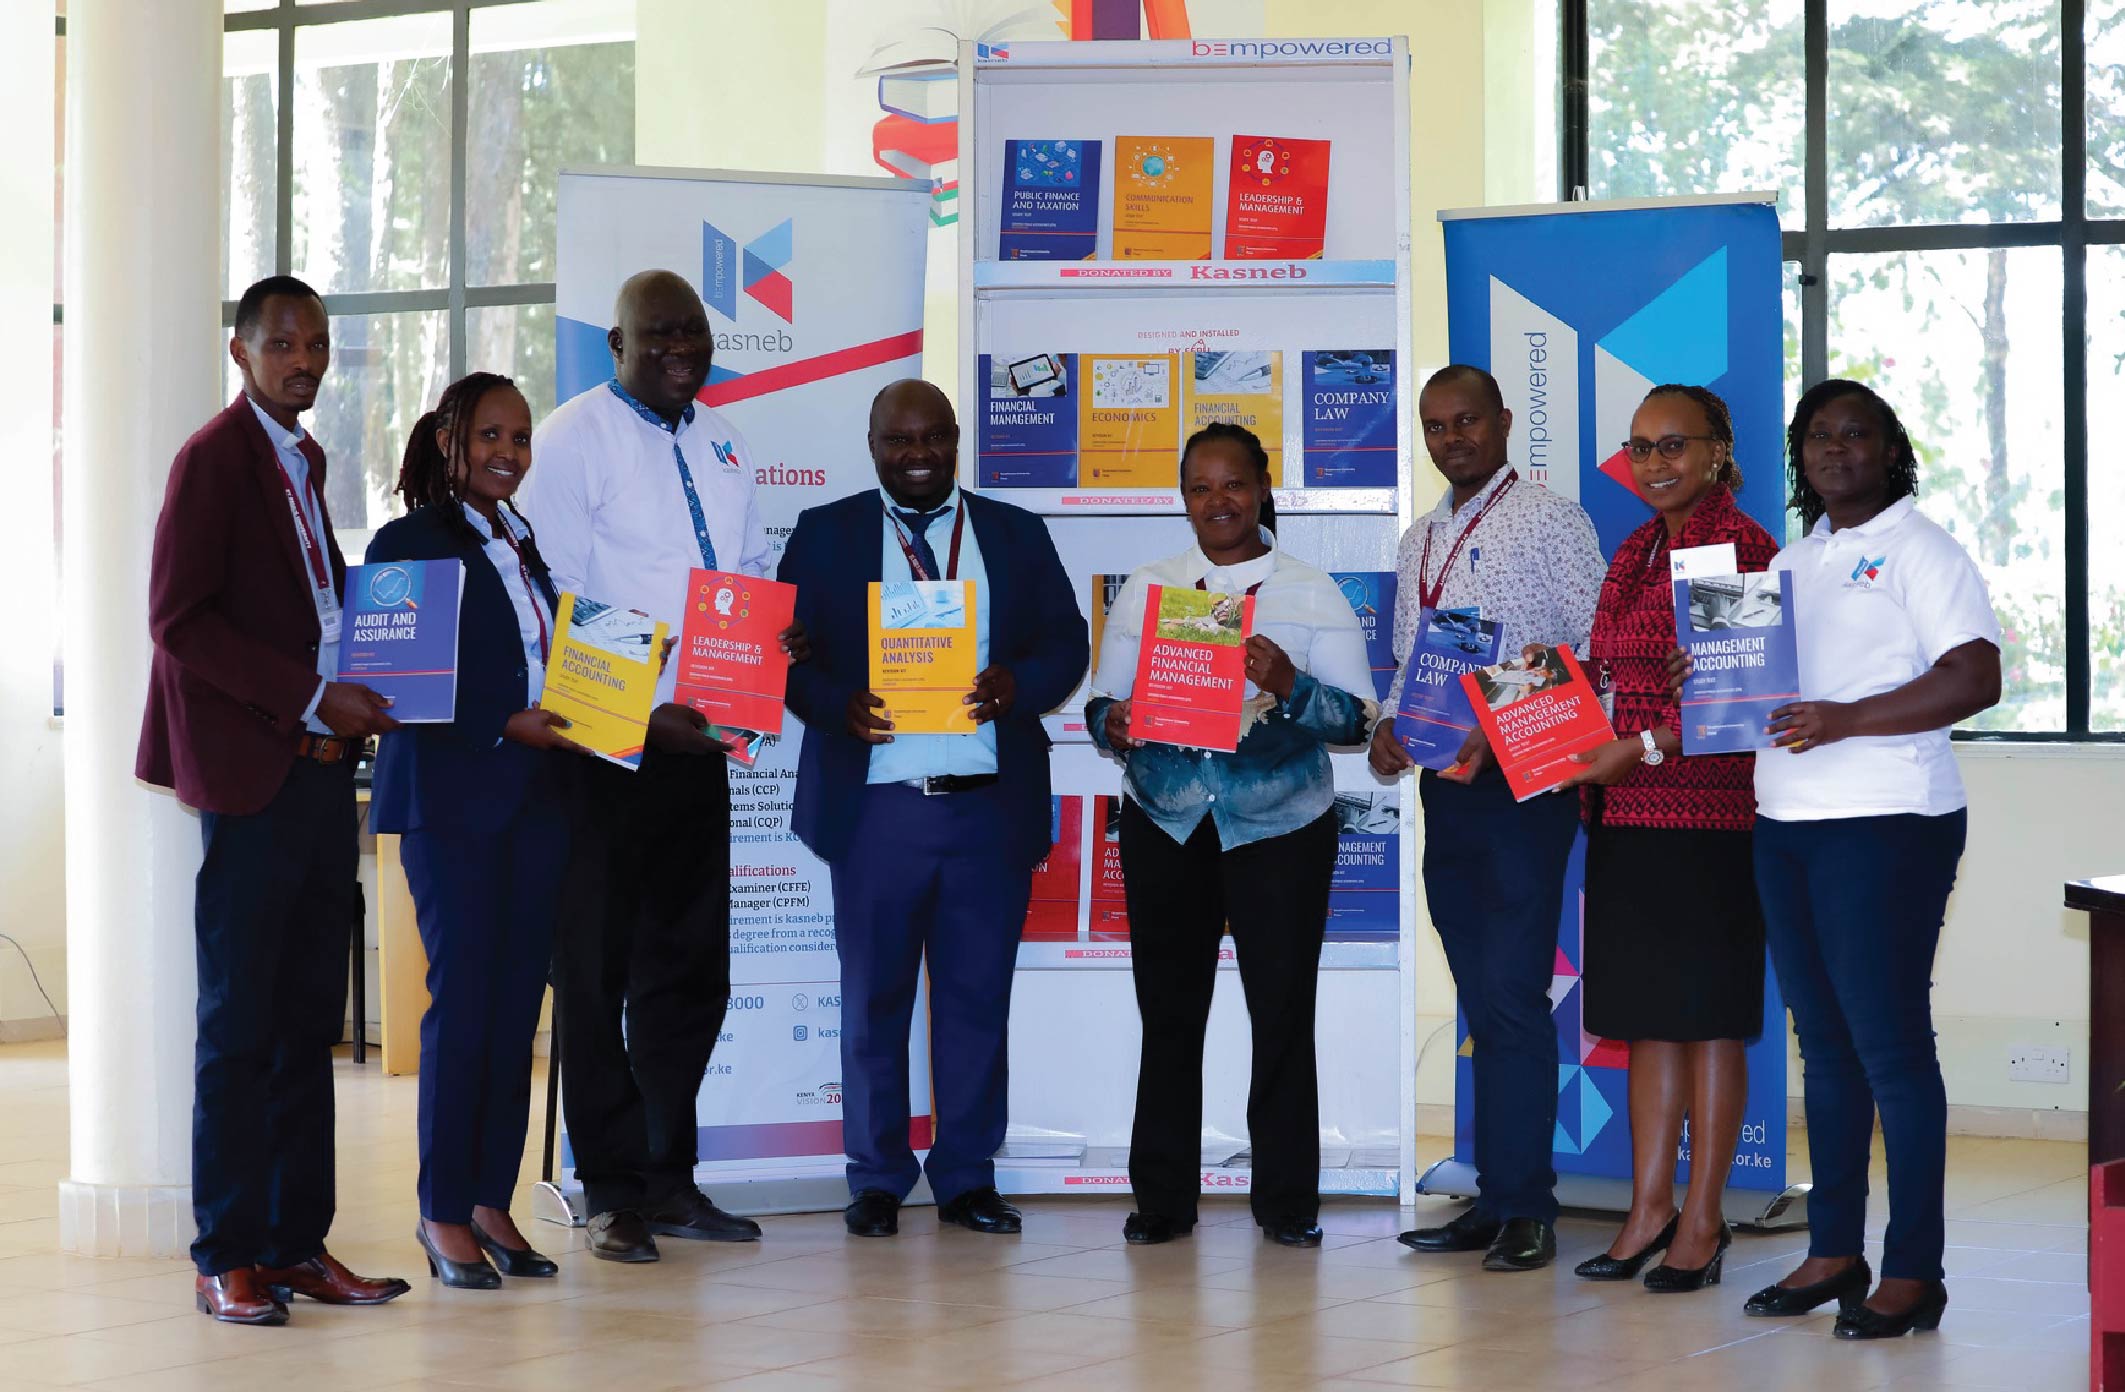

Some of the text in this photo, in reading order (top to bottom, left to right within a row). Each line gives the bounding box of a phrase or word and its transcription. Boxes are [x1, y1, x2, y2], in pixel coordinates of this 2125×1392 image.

[1014, 191, 1080, 201] PUBLIC FINANCE
[1125, 193, 1194, 204] COMMUNICATION
[1239, 193, 1303, 206] LEADERSHIP &
[1012, 201, 1079, 211] AND TAXATION
[1239, 202, 1305, 214] MANAGEMENT
[1190, 264, 1307, 279] Kasneb
[1180, 330, 1197, 338] AND
[1199, 329, 1240, 338] INSTALLED
[1314, 391, 1390, 405] COMPANY
[990, 400, 1037, 413] FINANCIAL
[1194, 402, 1241, 414] FINANCIAL
[1314, 407, 1350, 420] LAW
[1524, 331, 1553, 488] empowered
[990, 412, 1056, 425] MANAGEMENT
[1092, 412, 1157, 422] ECONOMICS
[1194, 414, 1257, 426] ACCOUNTING
[354, 612, 416, 628] AUDIT AND
[353, 626, 416, 642] ASSURANCE
[693, 635, 762, 655] LEADERSHIP &
[881, 636, 953, 650] QUANTITATIVE
[1690, 636, 1765, 656] MANAGEMENT
[563, 645, 612, 673] FINANCIAL
[692, 647, 764, 666] MANAGEMENT
[882, 651, 934, 664] ANALYSIS
[1153, 643, 1213, 661] ADVANCED
[1151, 655, 1212, 675] FINANCIAL
[1692, 652, 1765, 671] ACCOUNTING
[562, 659, 626, 692] ACCOUNTING
[1150, 669, 1234, 690] MANAGEMENT
[1416, 669, 1449, 687] LAW
[1496, 695, 1554, 725] ADVANCED
[1499, 696, 1581, 736] MANAGEMENT
[1505, 708, 1578, 746] ACCOUNTING
[730, 768, 778, 779] Financial
[752, 783, 780, 797] (CCP)
[754, 815, 783, 829] (CQP)
[774, 832, 783, 842] is
[1336, 854, 1385, 866] COUNTING
[773, 896, 810, 909] (CPFM)
[774, 914, 783, 924] is
[785, 911, 824, 924] kasneb
[732, 928, 770, 941] degree
[771, 928, 798, 938] from
[798, 930, 805, 938] a
